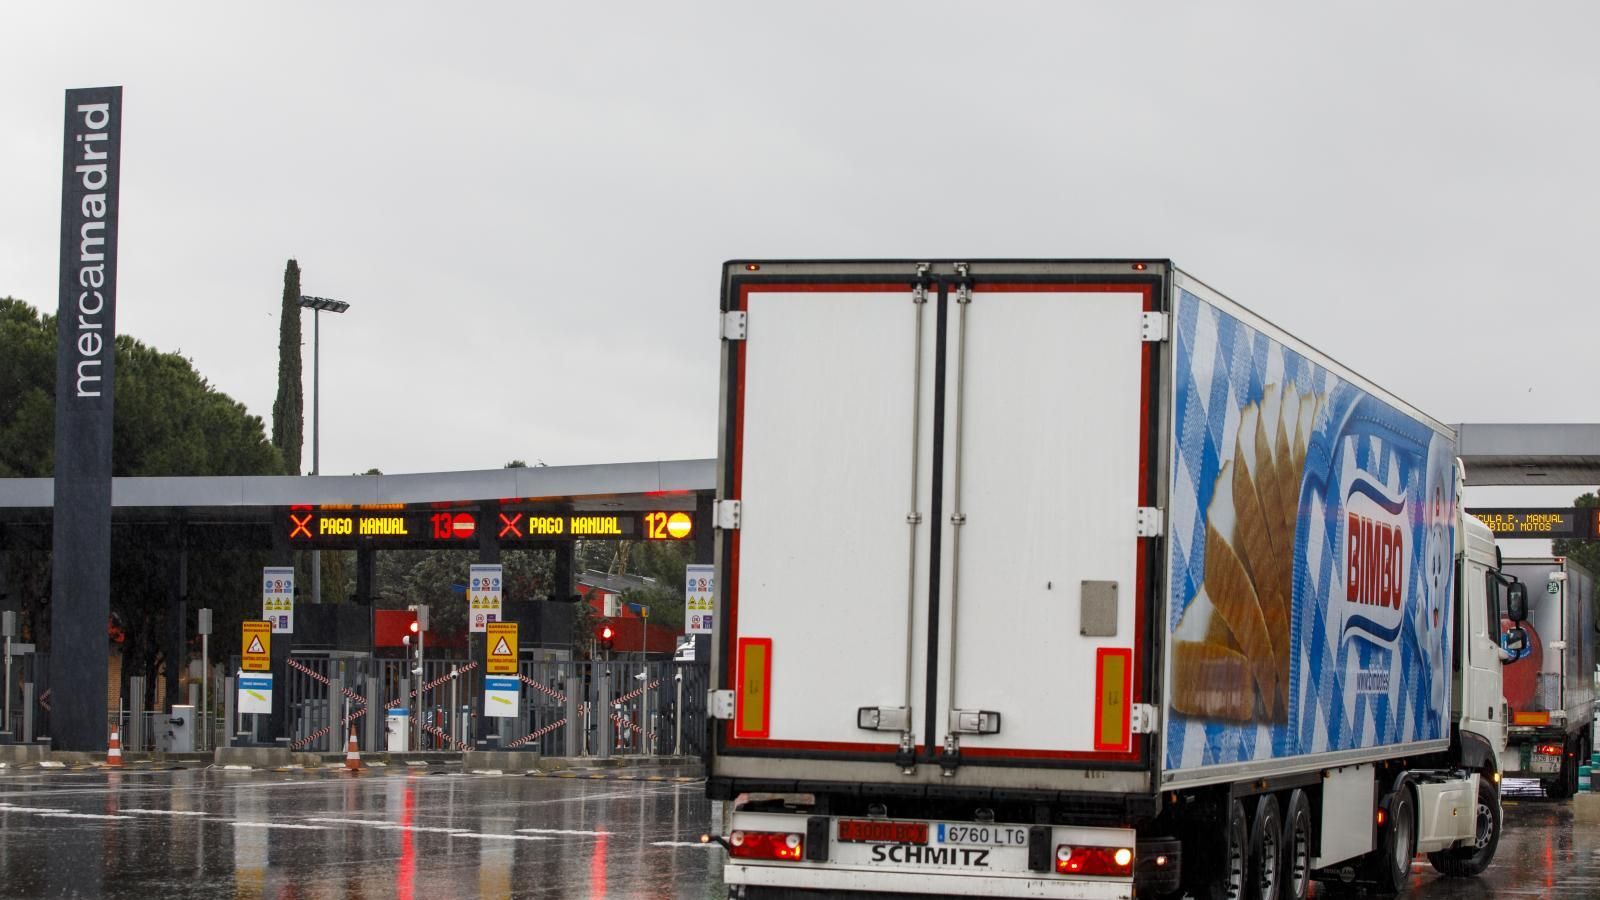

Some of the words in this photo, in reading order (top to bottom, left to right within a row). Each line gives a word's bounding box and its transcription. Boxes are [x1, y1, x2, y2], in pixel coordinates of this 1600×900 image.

[76, 102, 110, 398] mercamadrid
[319, 517, 352, 535] PAGO
[359, 517, 408, 535] MANUAL
[430, 512, 452, 539] 13
[529, 516, 564, 534] PAGO
[570, 516, 622, 534] MANUAL
[644, 511, 668, 539] 12
[1507, 514, 1519, 523] P.
[1526, 514, 1564, 523] MANUAL
[1520, 522, 1552, 532] MOTOS
[1346, 511, 1404, 611] BIMBO
[949, 827, 990, 844] 6760
[994, 829, 1026, 845] LTG
[871, 844, 990, 867] SCHMITZ
